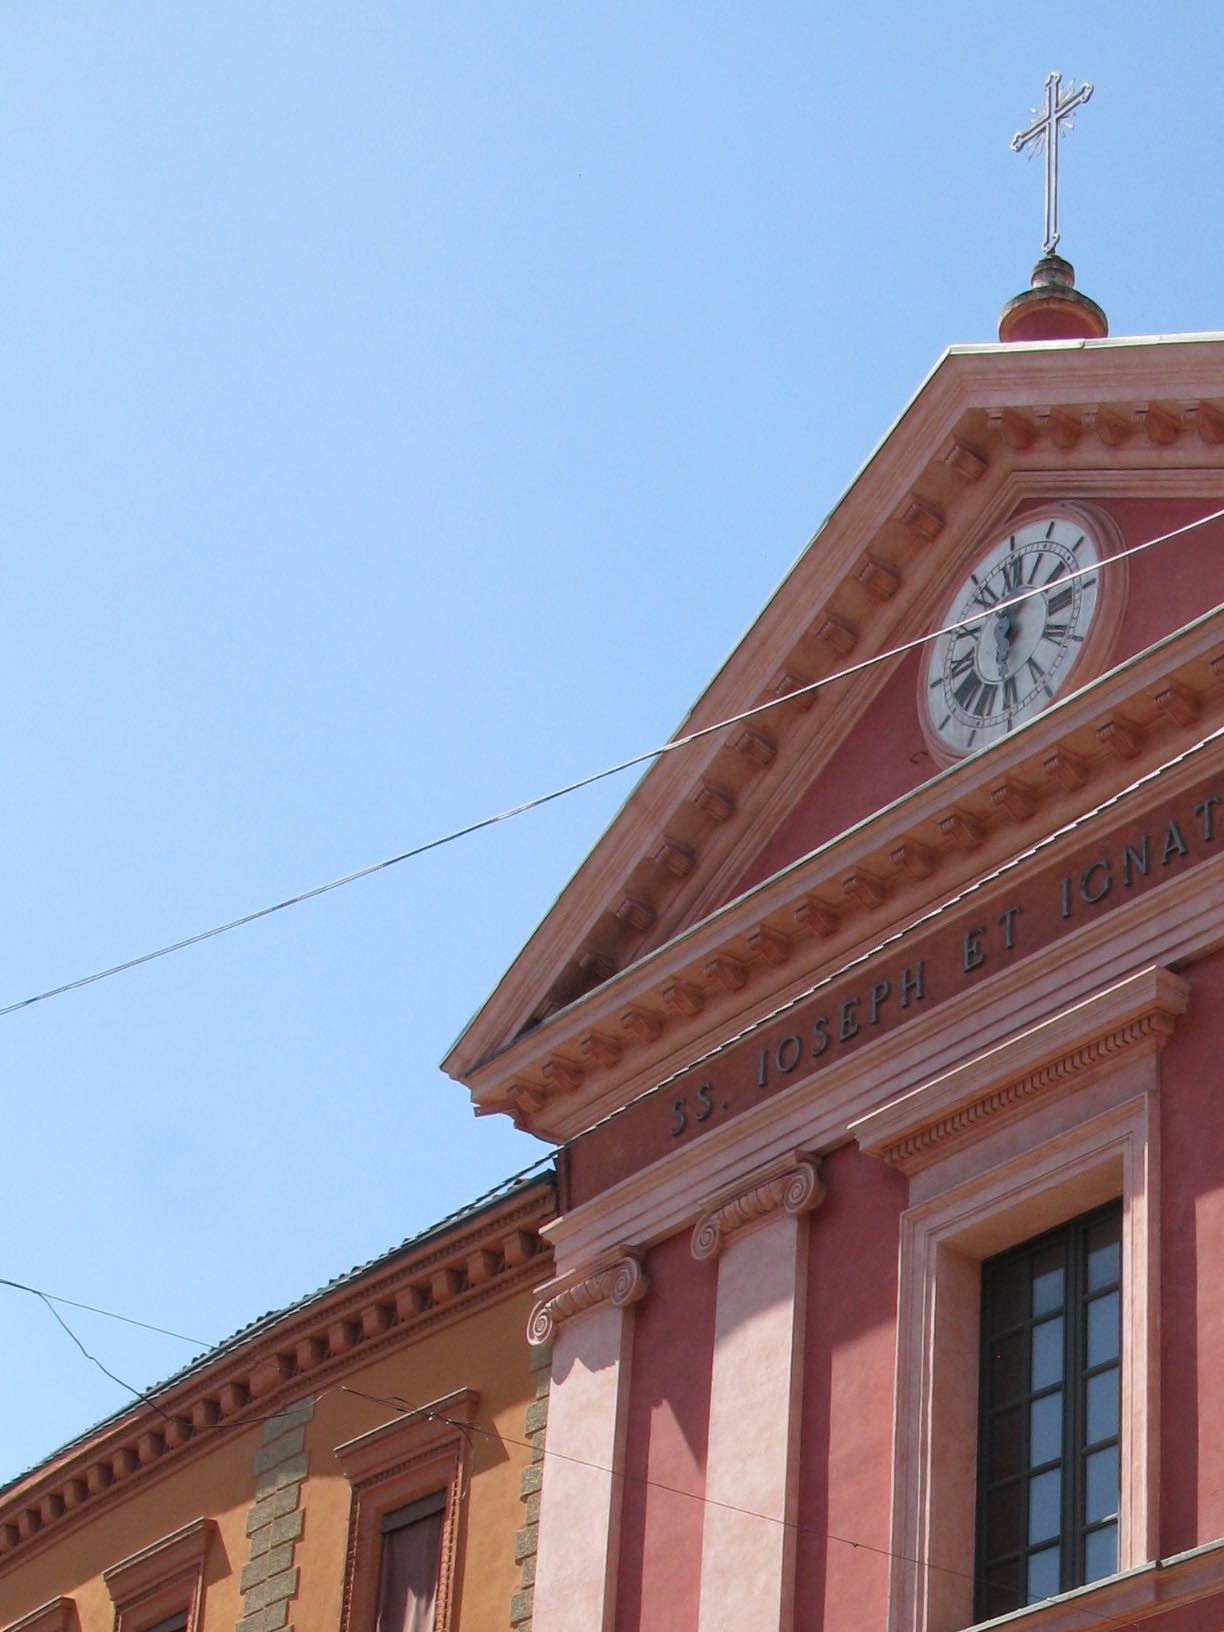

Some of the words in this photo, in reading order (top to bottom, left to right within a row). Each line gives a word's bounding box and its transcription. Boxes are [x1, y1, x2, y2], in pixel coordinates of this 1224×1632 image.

[669, 1081, 728, 1137] SS.
[758, 960, 925, 1087] IOSEPH
[962, 905, 1021, 973] ET
